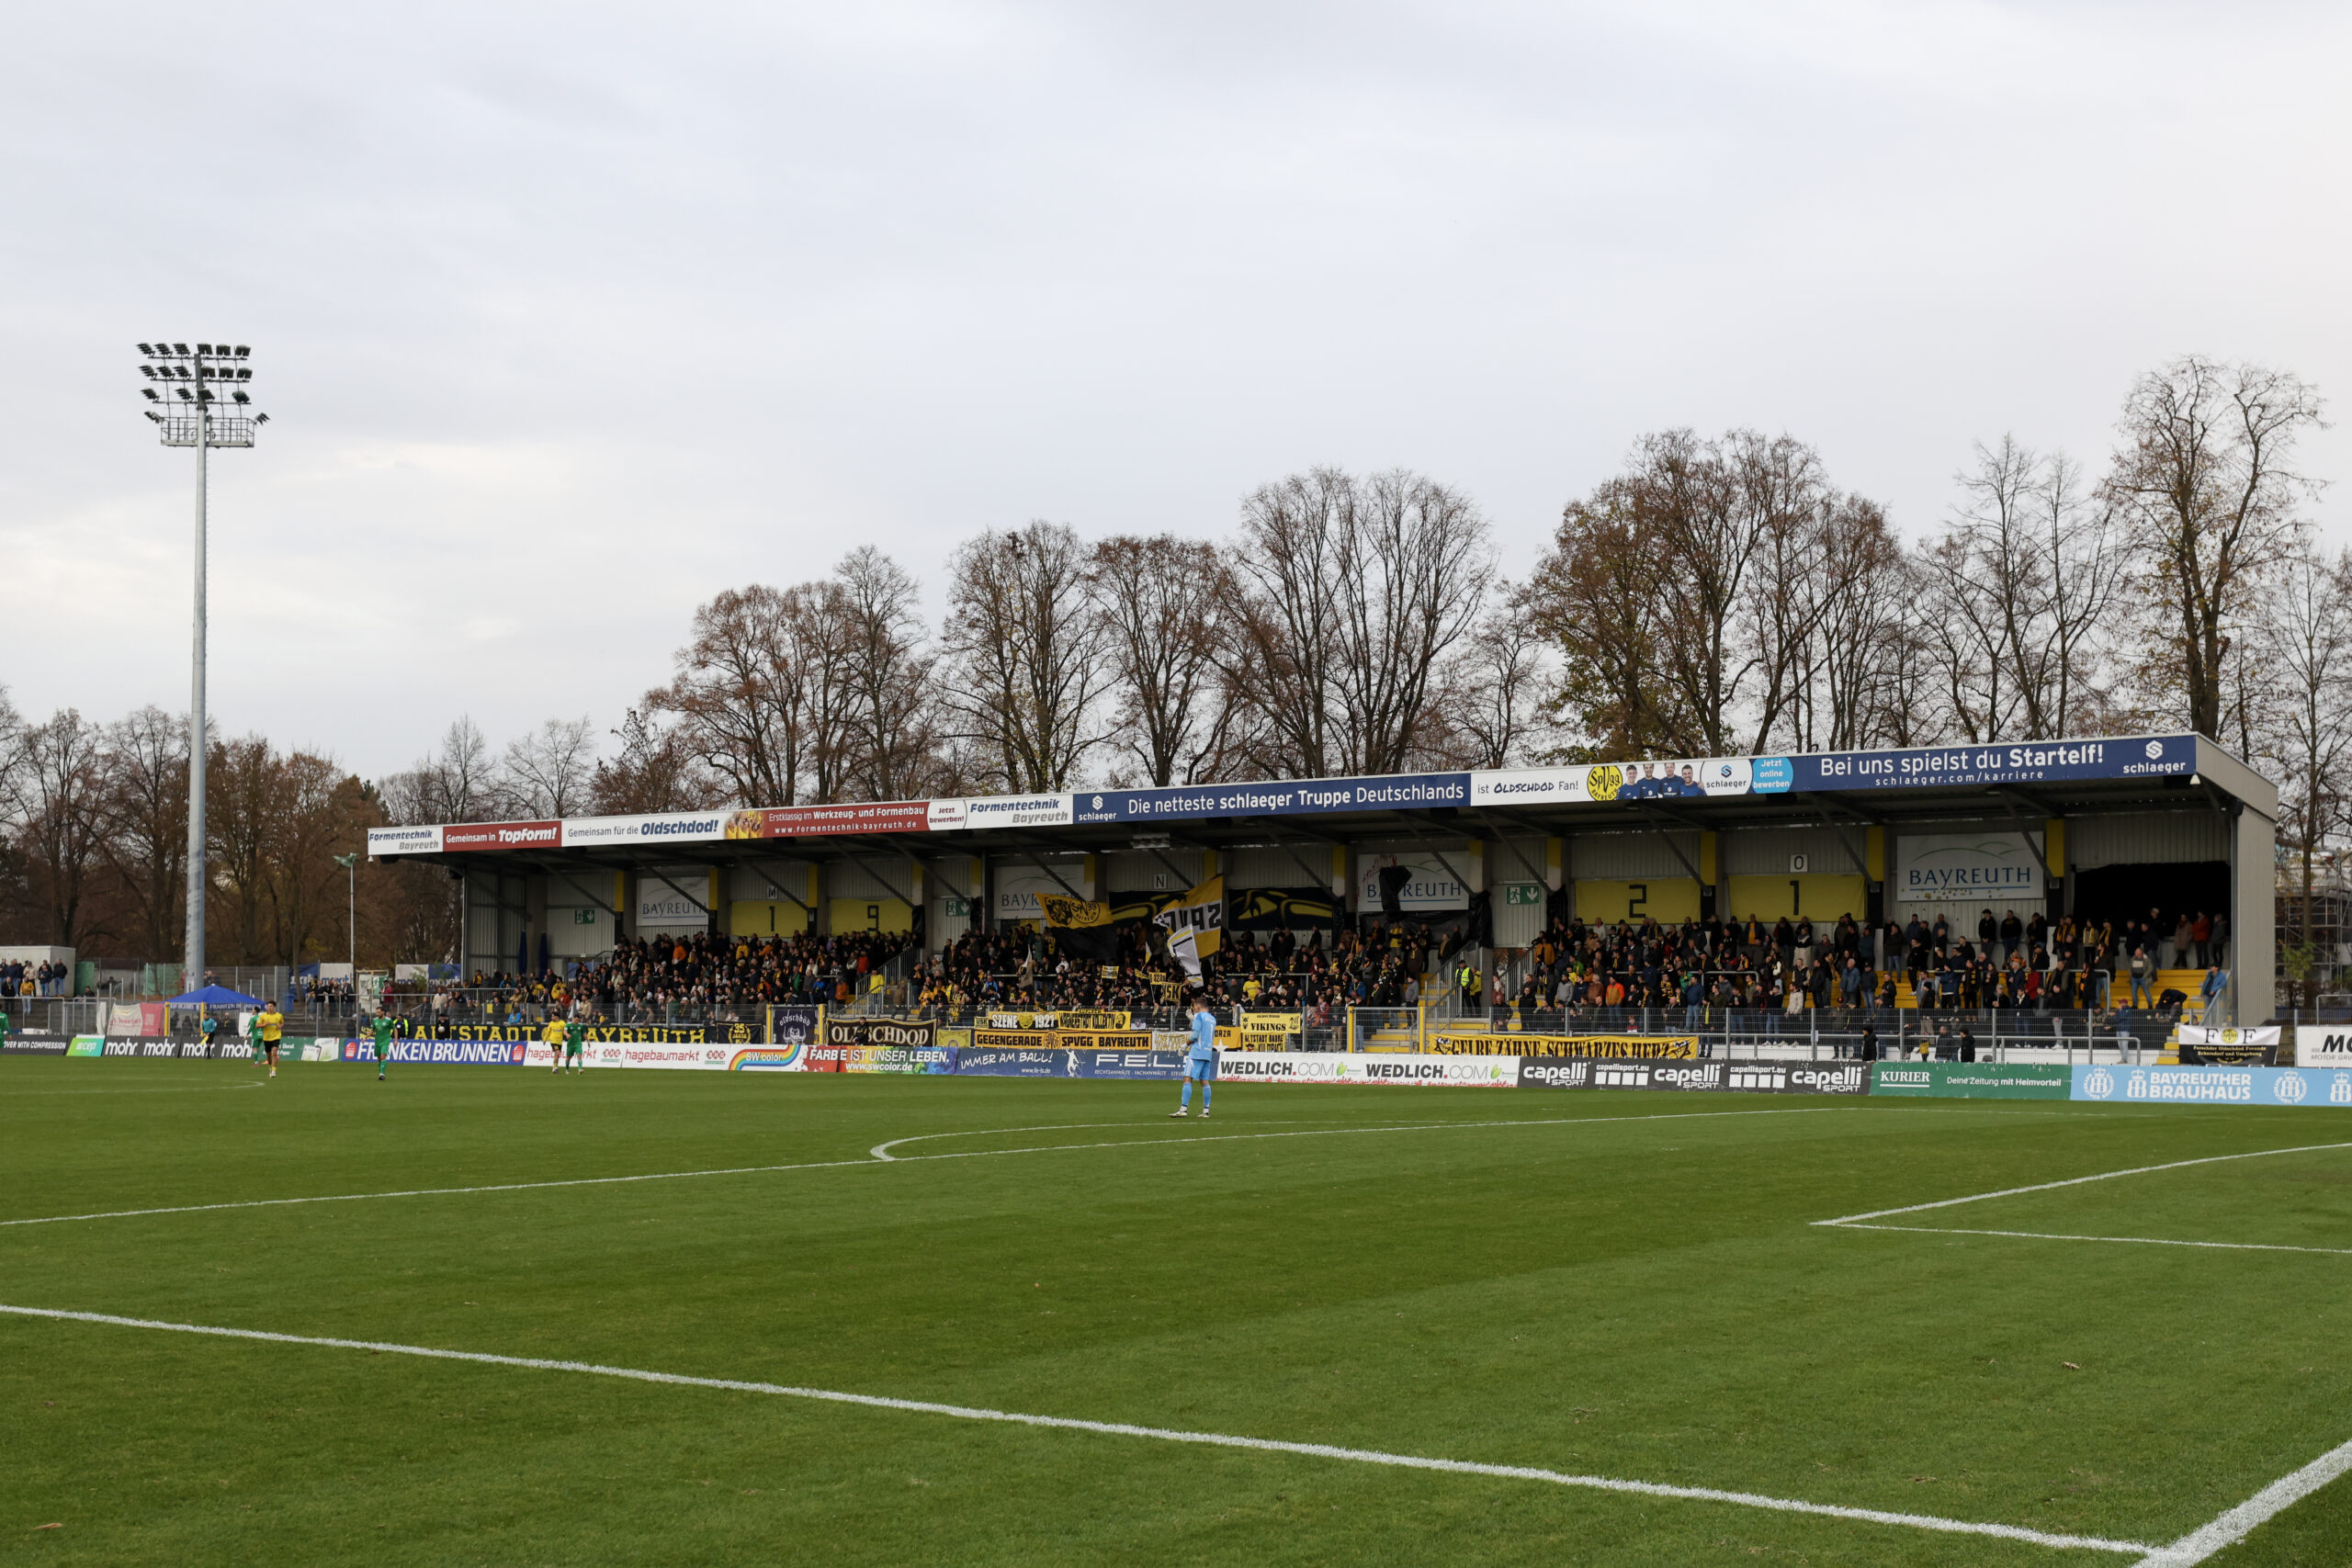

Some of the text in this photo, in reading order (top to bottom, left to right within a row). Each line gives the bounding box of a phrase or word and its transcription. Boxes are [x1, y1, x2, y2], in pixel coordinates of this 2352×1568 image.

[1760, 760, 1782, 768] Jetzt
[1820, 744, 2103, 776] Bei uns spielst du Startelf!
[1759, 770, 1783, 778] online
[2122, 761, 2186, 774] schlaeger
[1706, 780, 1747, 790] schlaeger
[1753, 779, 1790, 789] bewerben
[1875, 772, 2043, 786] schlaeger.com/karriere
[1477, 781, 1578, 794] ist OLDSCHDOD Fan!
[1127, 783, 1464, 814] Die netteste schlaeger Truppe Deutschlands
[970, 799, 1059, 814] Formentechnik
[768, 806, 924, 823] Erstklassig im Werkzeug- und Formenbau
[929, 815, 965, 824] bewerben!
[1012, 811, 1068, 825] Bayreuth
[1078, 811, 1116, 823] schlaeger
[568, 819, 719, 838] Gemeinsam für die Oldschdod!
[775, 820, 918, 833] www.formentechnik-bayreuth.de
[368, 829, 433, 841] Formentechnik
[446, 827, 558, 845] Gemeinsam in Topform!
[399, 840, 439, 852] Bayreuth
[1156, 875, 1165, 887] N
[1909, 867, 2030, 890] BAYREUTH
[768, 887, 776, 897] M
[1366, 882, 1462, 898] BREUTH
[1628, 884, 1646, 919] 2
[1790, 880, 1799, 916] 1
[733, 1022, 745, 1033] 35
[992, 1013, 1056, 1028] SZENE 1921
[585, 1026, 706, 1043] AYREUTH
[831, 1026, 928, 1045] OLSCHDOD
[977, 1034, 1043, 1046] GEGENGERADE
[1061, 1036, 1093, 1047] SPVGG
[1099, 1036, 1148, 1047] BAYREUTH
[1214, 1030, 1231, 1038] ORZA
[2205, 1028, 2256, 1044] F F
[17, 1041, 30, 1049] WITH
[30, 1041, 67, 1050] COMPRESSION
[221, 1039, 253, 1057] moh
[356, 1041, 511, 1063] FRNKEN BRUNNEN
[527, 1048, 596, 1061] hageurkt
[626, 1049, 700, 1064] hagebaumarkt
[746, 1052, 783, 1062] SW color
[809, 1049, 950, 1063] FARBE IST UNSER LEBEN.
[961, 1052, 1054, 1070] IMMER AM BALL!
[845, 1062, 913, 1071] www.swcolor.de
[1220, 1061, 1335, 1077] WEDLICH.COM
[1366, 1064, 1488, 1079] WEDLICH.COM
[1523, 1063, 1588, 1084] capelli
[1596, 1065, 1650, 1073] capellisport.eu
[1729, 1066, 1787, 1074] capellisport.eu
[1654, 1065, 1721, 1087] capelli
[1791, 1066, 1862, 1089] capelli
[1880, 1071, 1930, 1082] KURIER
[1947, 1076, 2062, 1088] Deine Zeitung mit Heimvorteil
[2150, 1072, 2251, 1085] BAYREUTHER
[2149, 1085, 2251, 1100] BRAUHAUS
